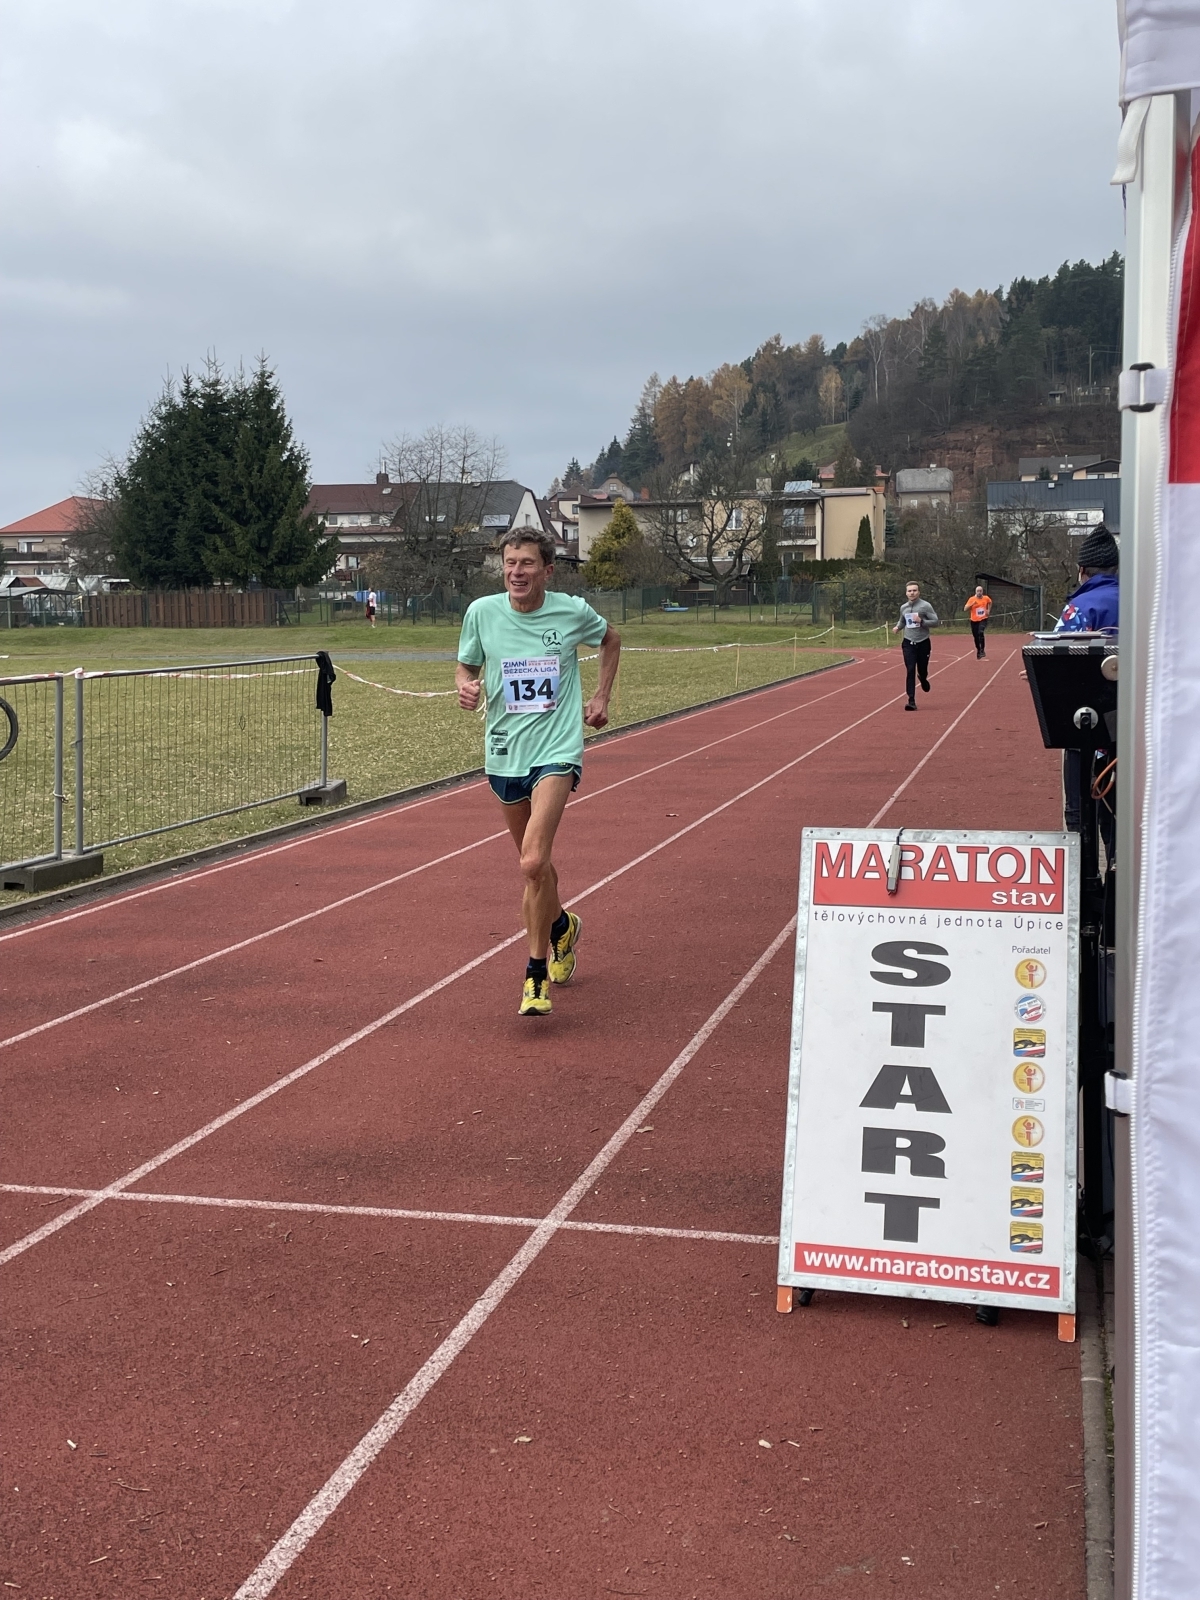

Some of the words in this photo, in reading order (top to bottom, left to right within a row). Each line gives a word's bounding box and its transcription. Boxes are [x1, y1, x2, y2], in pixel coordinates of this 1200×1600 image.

[502, 659, 527, 668] ZIMNÍ
[509, 678, 554, 701] 134
[815, 842, 1065, 886] MARATON
[991, 888, 1056, 907] stav
[813, 910, 928, 926] tělovýchovná
[936, 914, 1003, 929] jednota
[1013, 916, 1064, 932] Úpice
[1011, 945, 1051, 955] Pořadatel
[858, 940, 953, 1243] START
[803, 1249, 1051, 1290] www.maratonstav.cz
